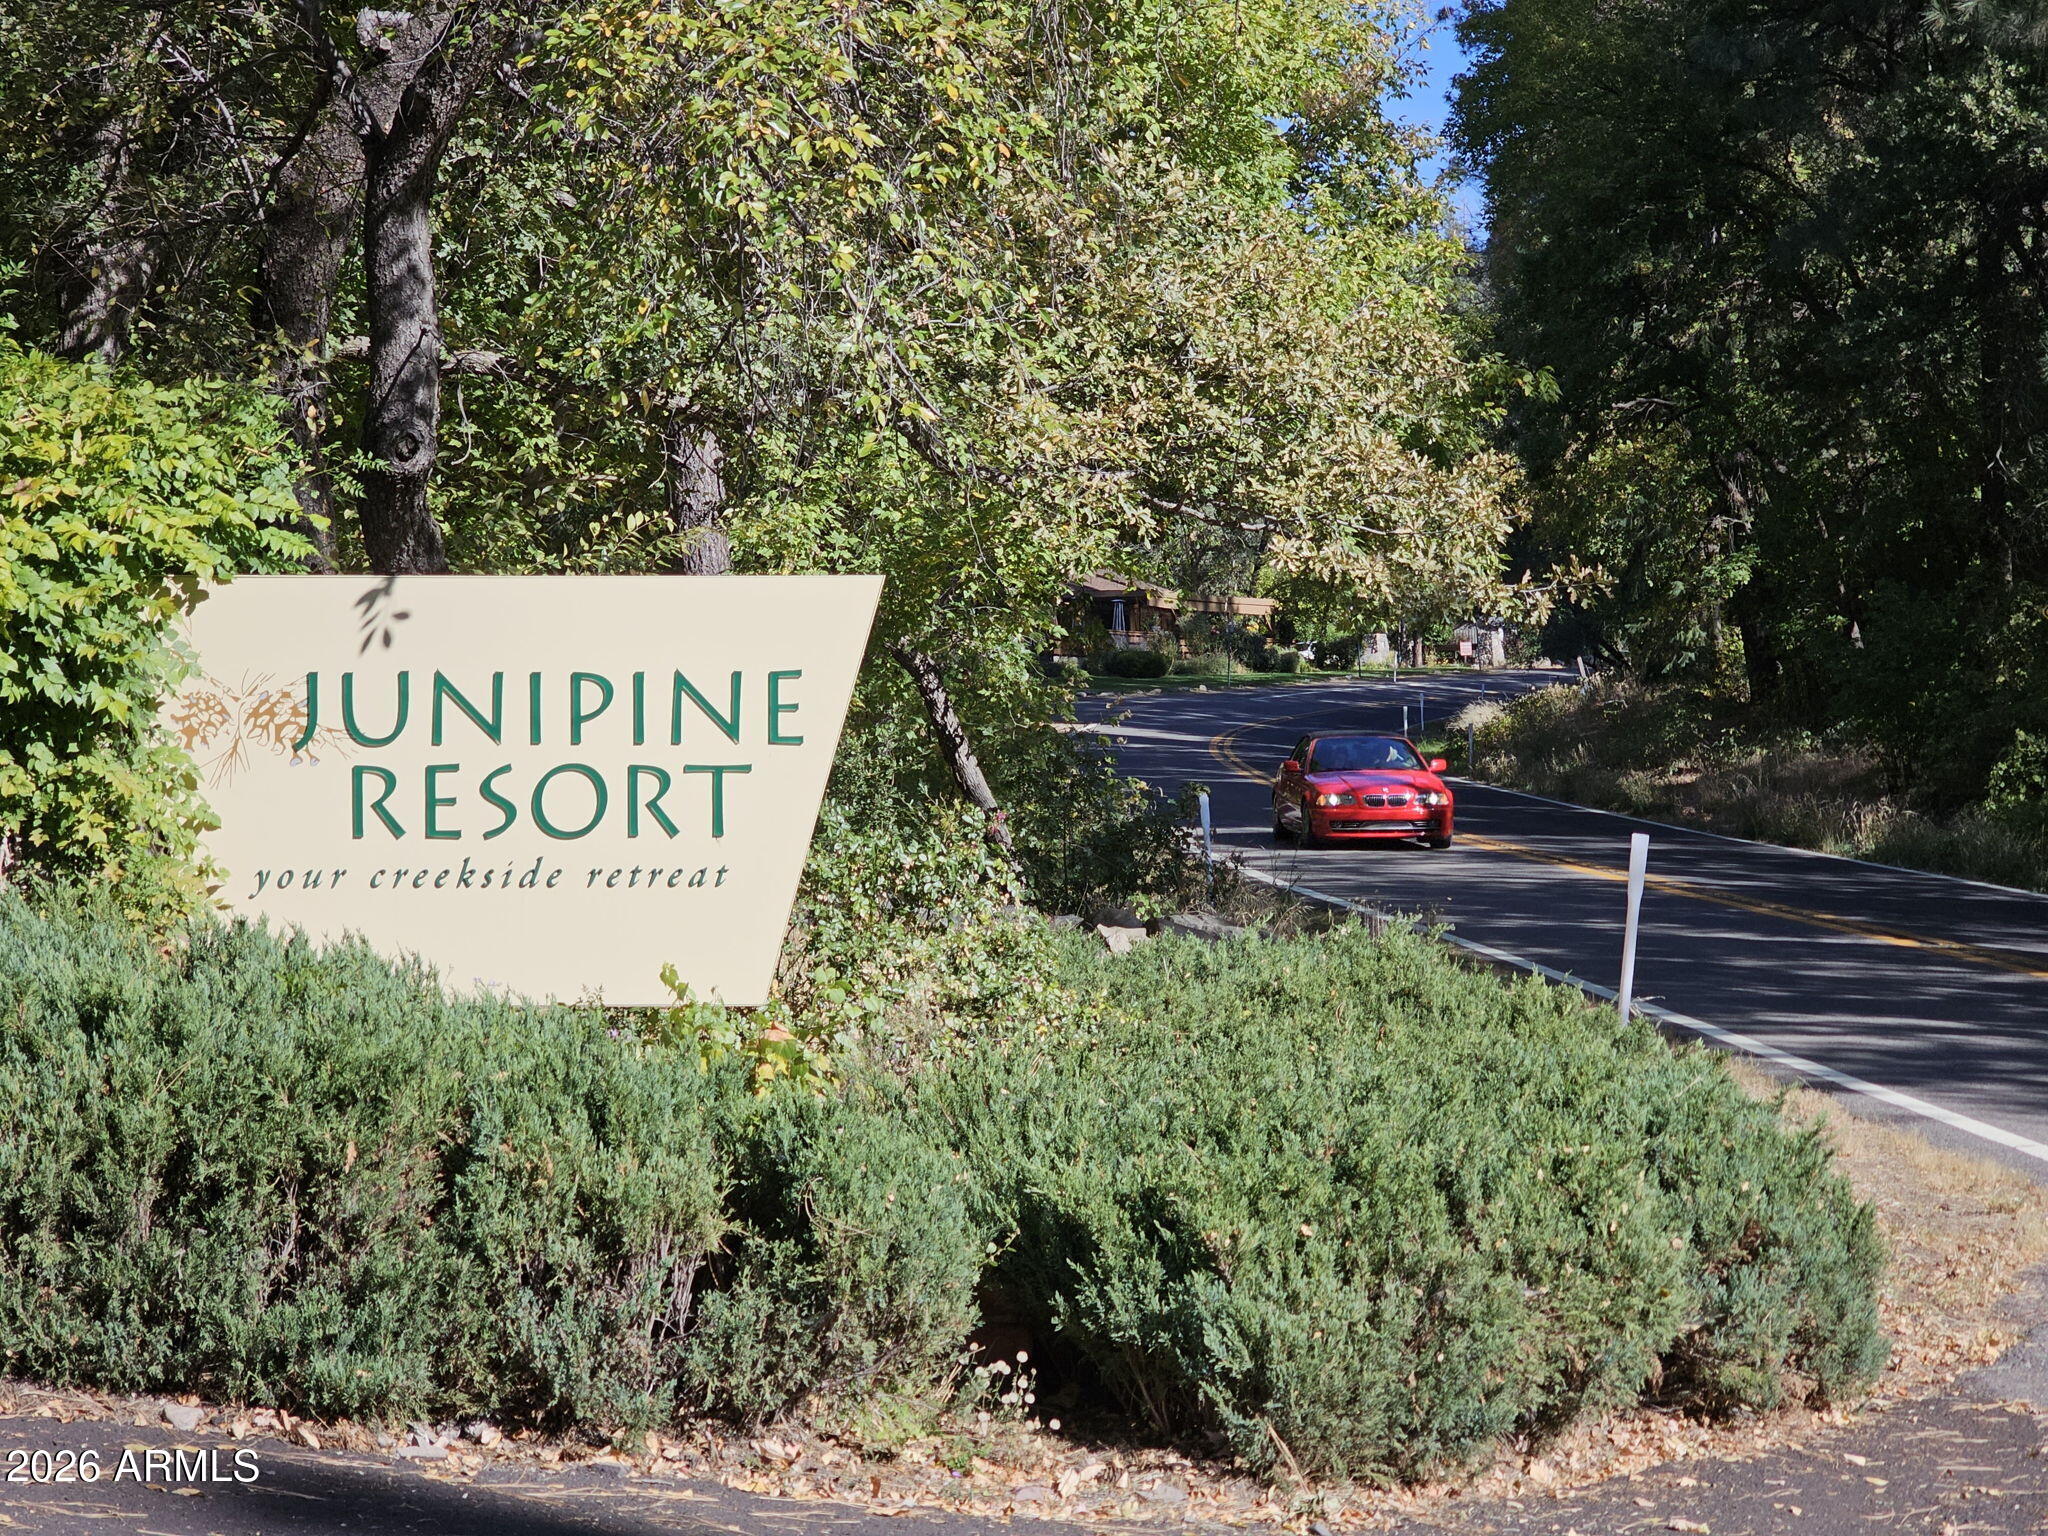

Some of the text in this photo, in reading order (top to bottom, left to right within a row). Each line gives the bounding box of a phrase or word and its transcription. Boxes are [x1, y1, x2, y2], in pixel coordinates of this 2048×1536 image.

[291, 668, 804, 754] JUNIPINE
[351, 763, 753, 841] RESORT
[248, 856, 730, 900] your creekside retreat
